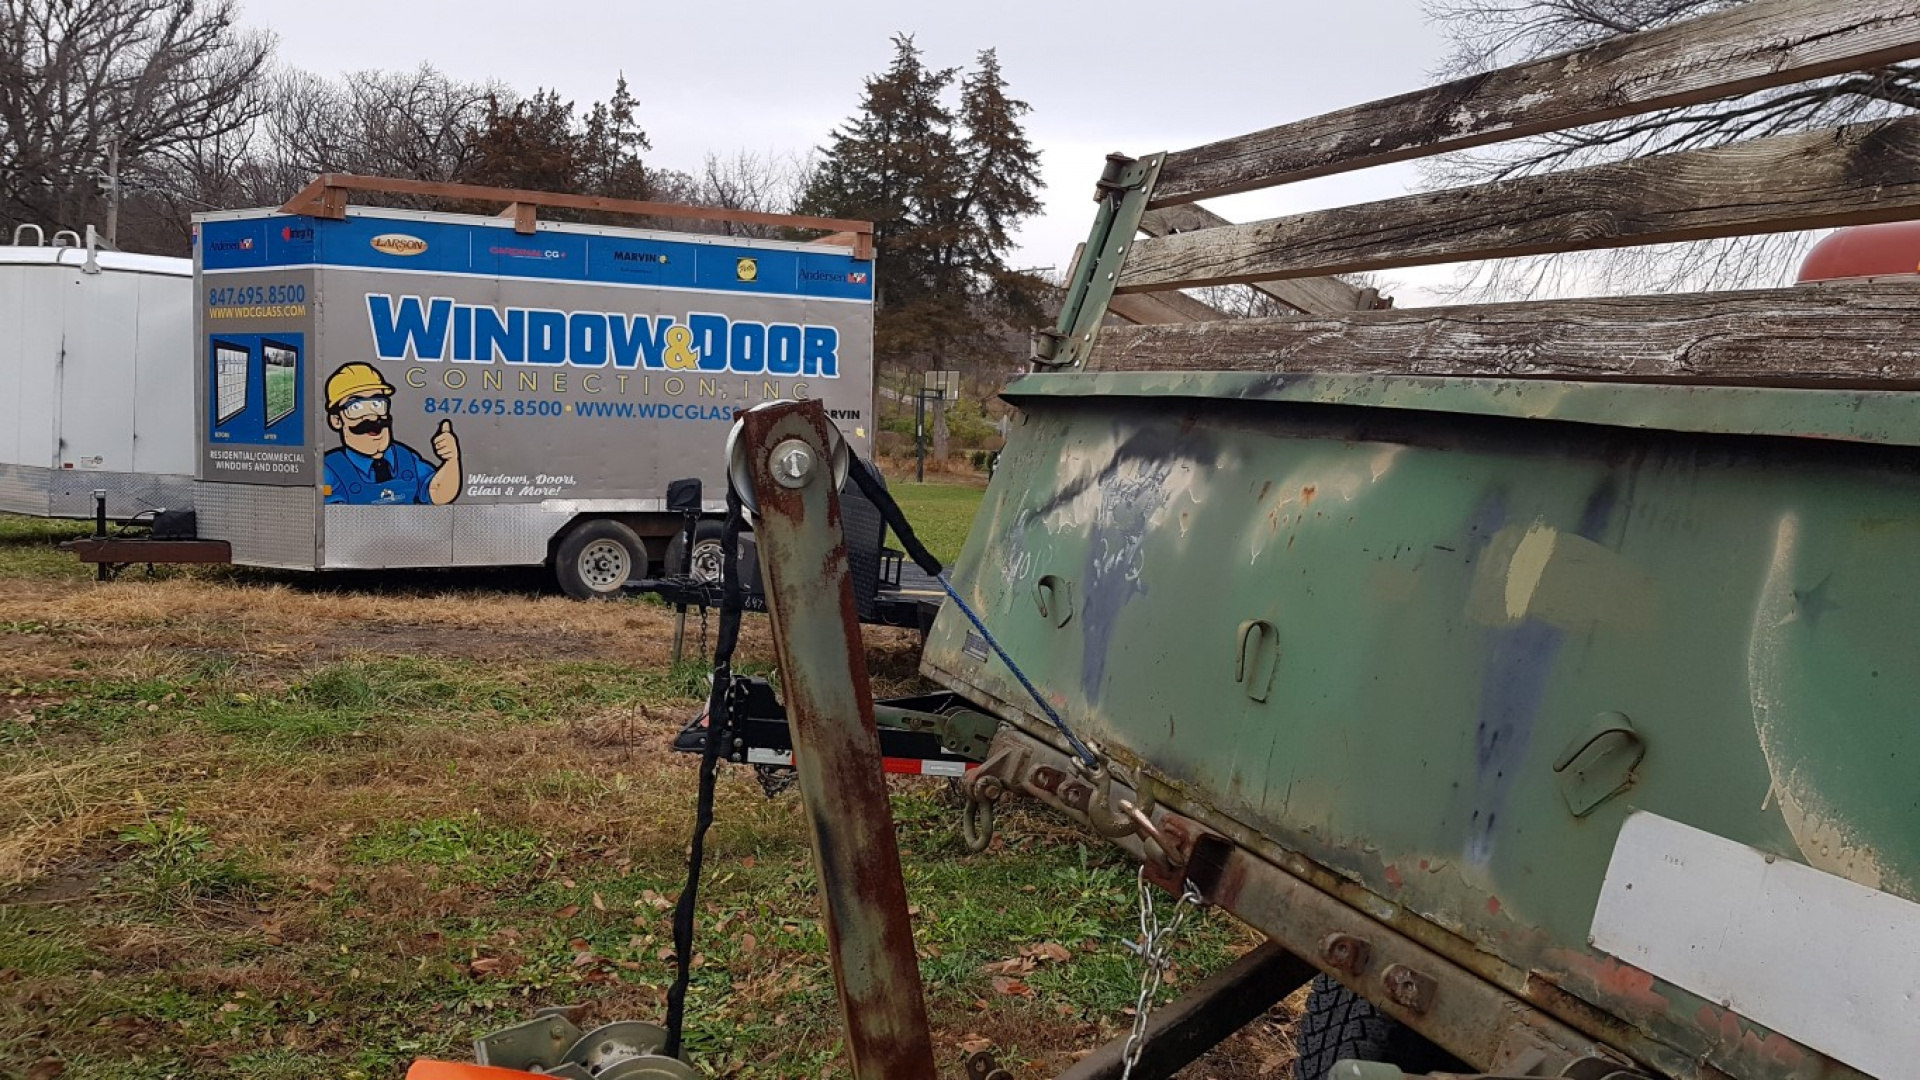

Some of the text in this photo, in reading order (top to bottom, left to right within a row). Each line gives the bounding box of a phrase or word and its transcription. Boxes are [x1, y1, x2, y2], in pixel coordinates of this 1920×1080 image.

[376, 238, 423, 251] LARSON
[614, 251, 656, 263] MARVIN
[799, 268, 846, 283] Andersen
[209, 284, 305, 305] 847.695.8500
[424, 397, 563, 418] 847.695.8500
[215, 460, 299, 474] WINDOWS AND DOORS
[467, 473, 577, 486] Windows, Doors,
[467, 485, 562, 497] Glass & More!
